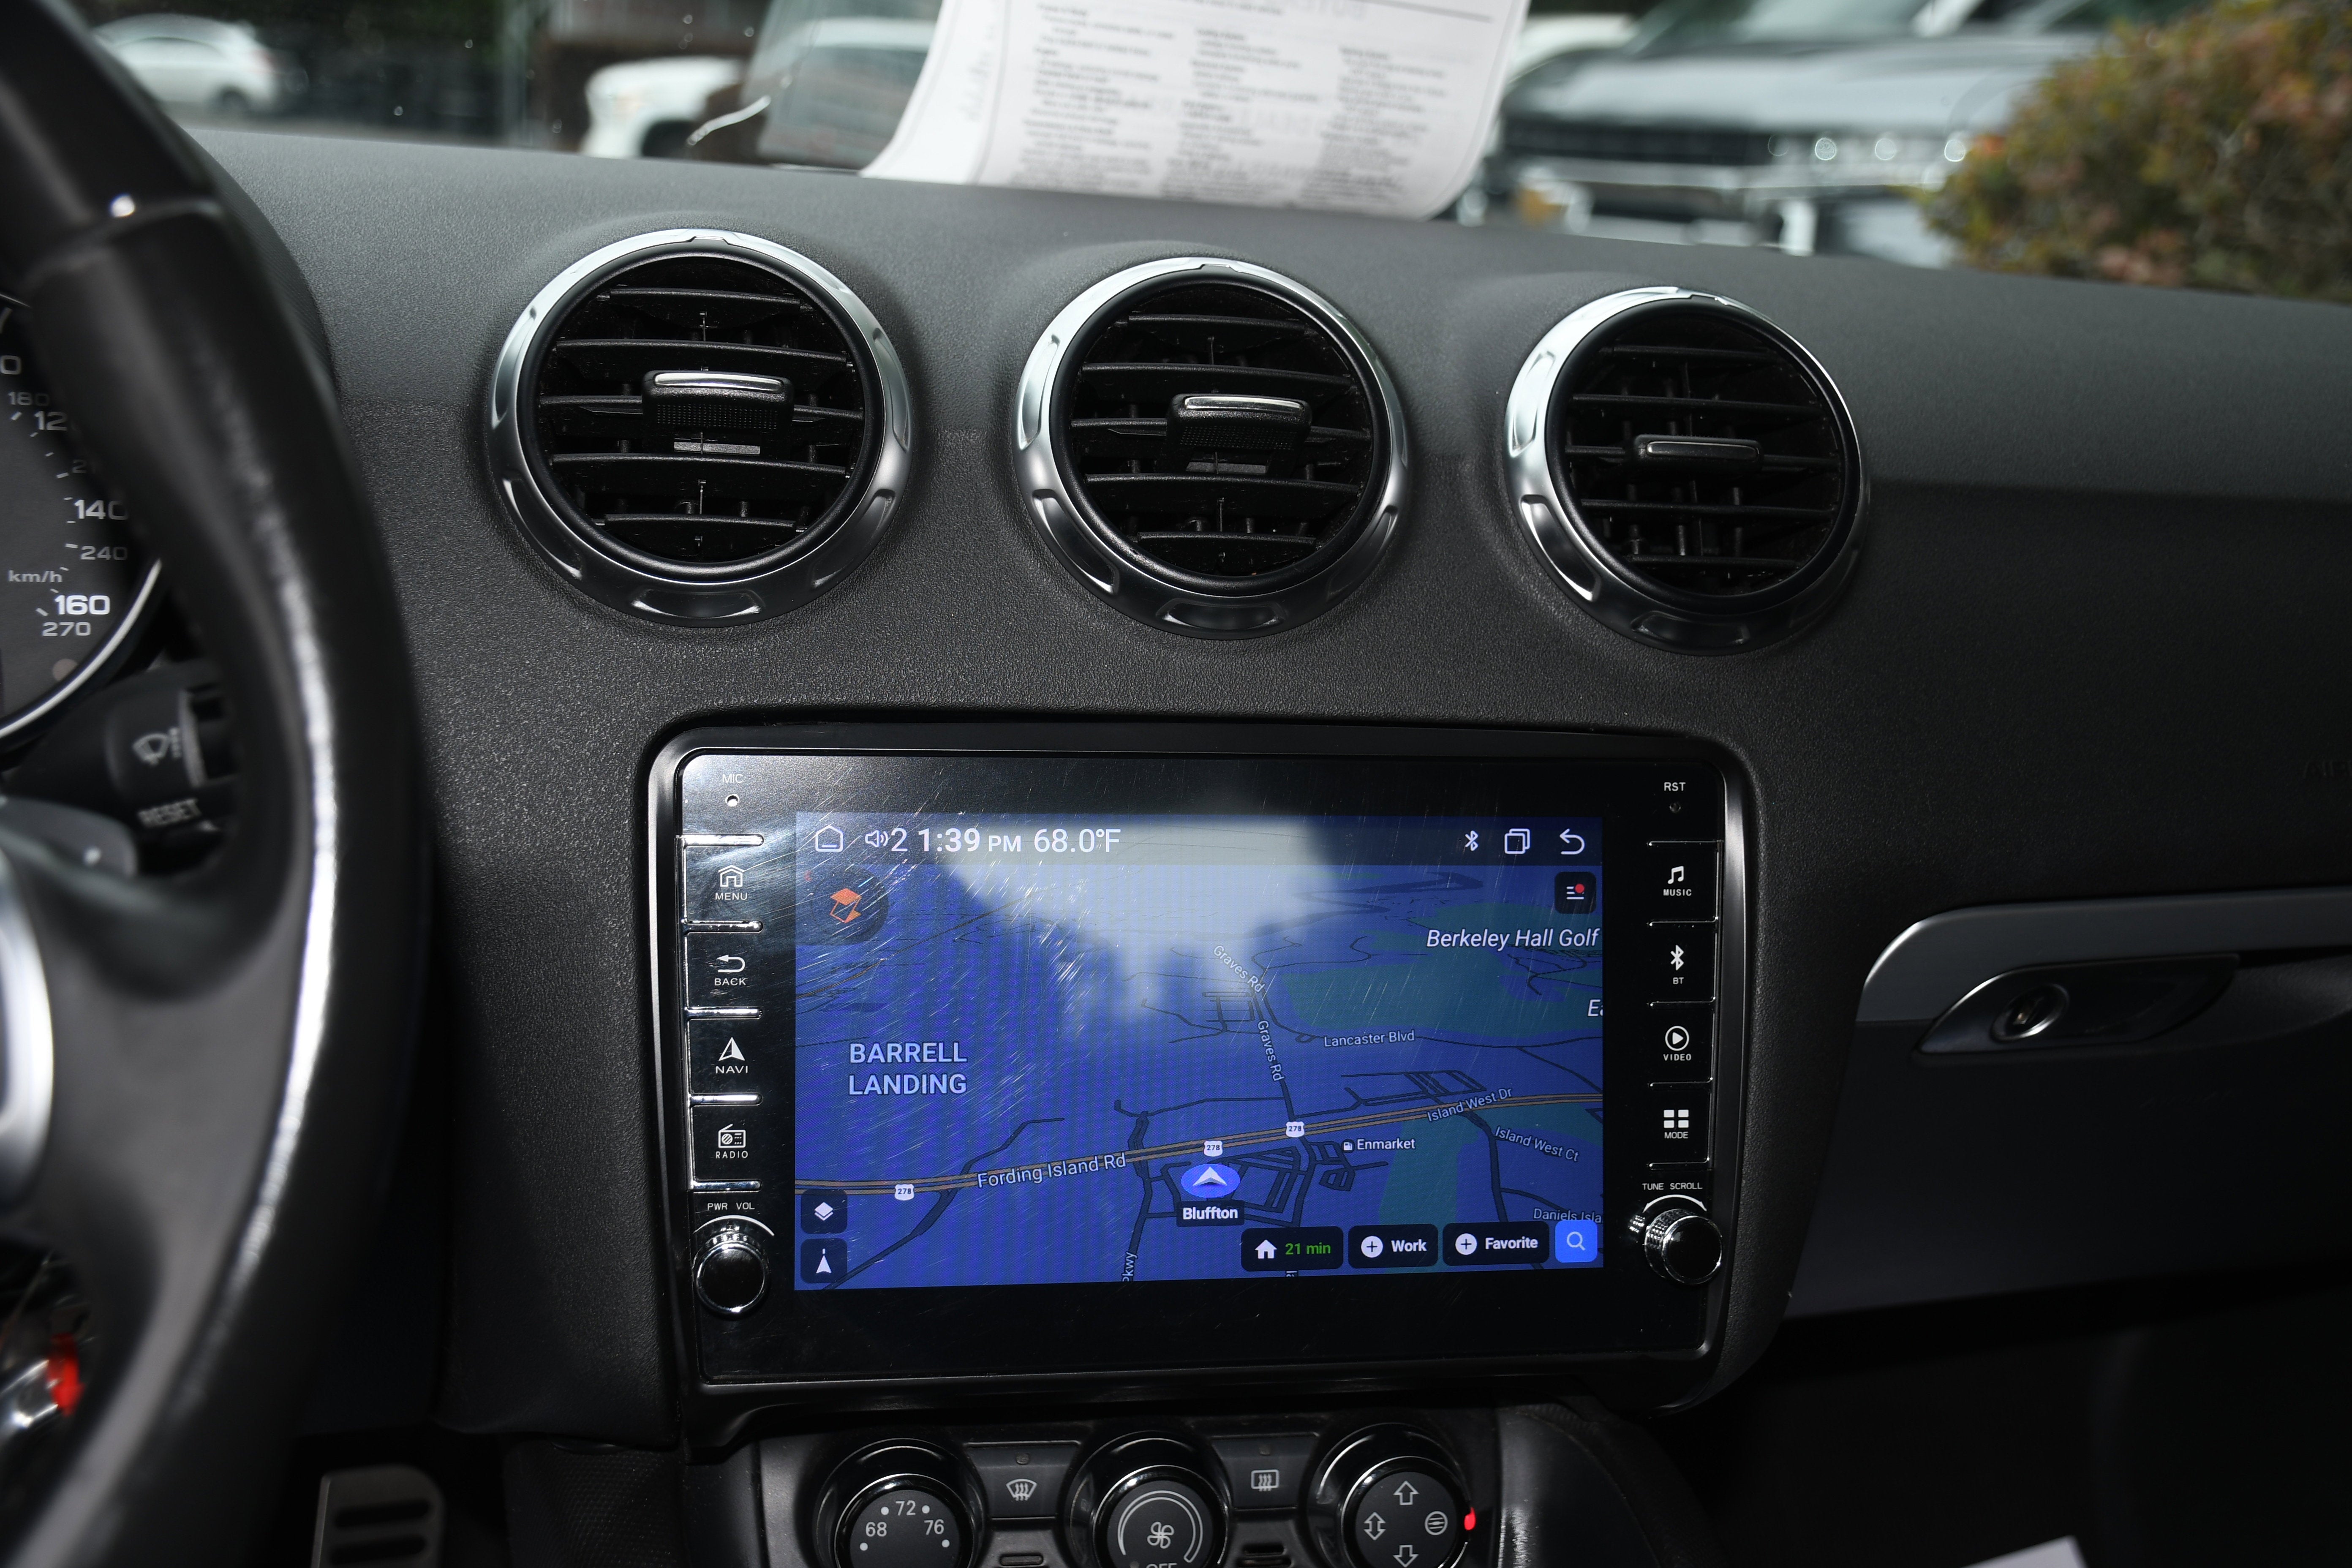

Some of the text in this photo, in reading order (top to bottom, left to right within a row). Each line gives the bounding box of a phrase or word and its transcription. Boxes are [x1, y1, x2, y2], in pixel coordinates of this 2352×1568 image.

[8, 392, 50, 406] 180
[34, 411, 68, 431] 12
[81, 547, 128, 560] 240
[8, 570, 63, 583] km/h
[55, 595, 111, 615] 160
[42, 622, 92, 637] 270
[722, 774, 744, 784] MIC
[1664, 782, 1686, 791] RST
[891, 828, 1122, 852] 2 1:39 PM 68.0°F
[715, 893, 748, 901] MENU
[1426, 928, 1601, 951] Berkeley Hall Golf
[1214, 945, 1265, 993] Graves Rd
[1588, 999, 1603, 1016] E
[1324, 1030, 1415, 1047] Lancaster Blvd
[850, 1042, 967, 1063] BARRELL
[1258, 1021, 1285, 1081] Graves Rd
[715, 1065, 748, 1074] NAVI
[849, 1074, 967, 1095] LANDING
[1427, 1087, 1513, 1123] Island West Dr
[1357, 1138, 1416, 1150] Enmarket
[1494, 1126, 1580, 1162] Island West Ct
[977, 1152, 1126, 1188] Fording Island Rd
[736, 1202, 755, 1210] VOL
[1182, 1206, 1238, 1220] Bluffton
[1534, 1208, 1577, 1220] Daniels
[1285, 1242, 1331, 1255] 21 min
[1391, 1239, 1427, 1252] Work
[1485, 1237, 1538, 1250] Favorite
[895, 1500, 916, 1516] 72
[866, 1522, 887, 1537] 68
[924, 1519, 945, 1535] 76
